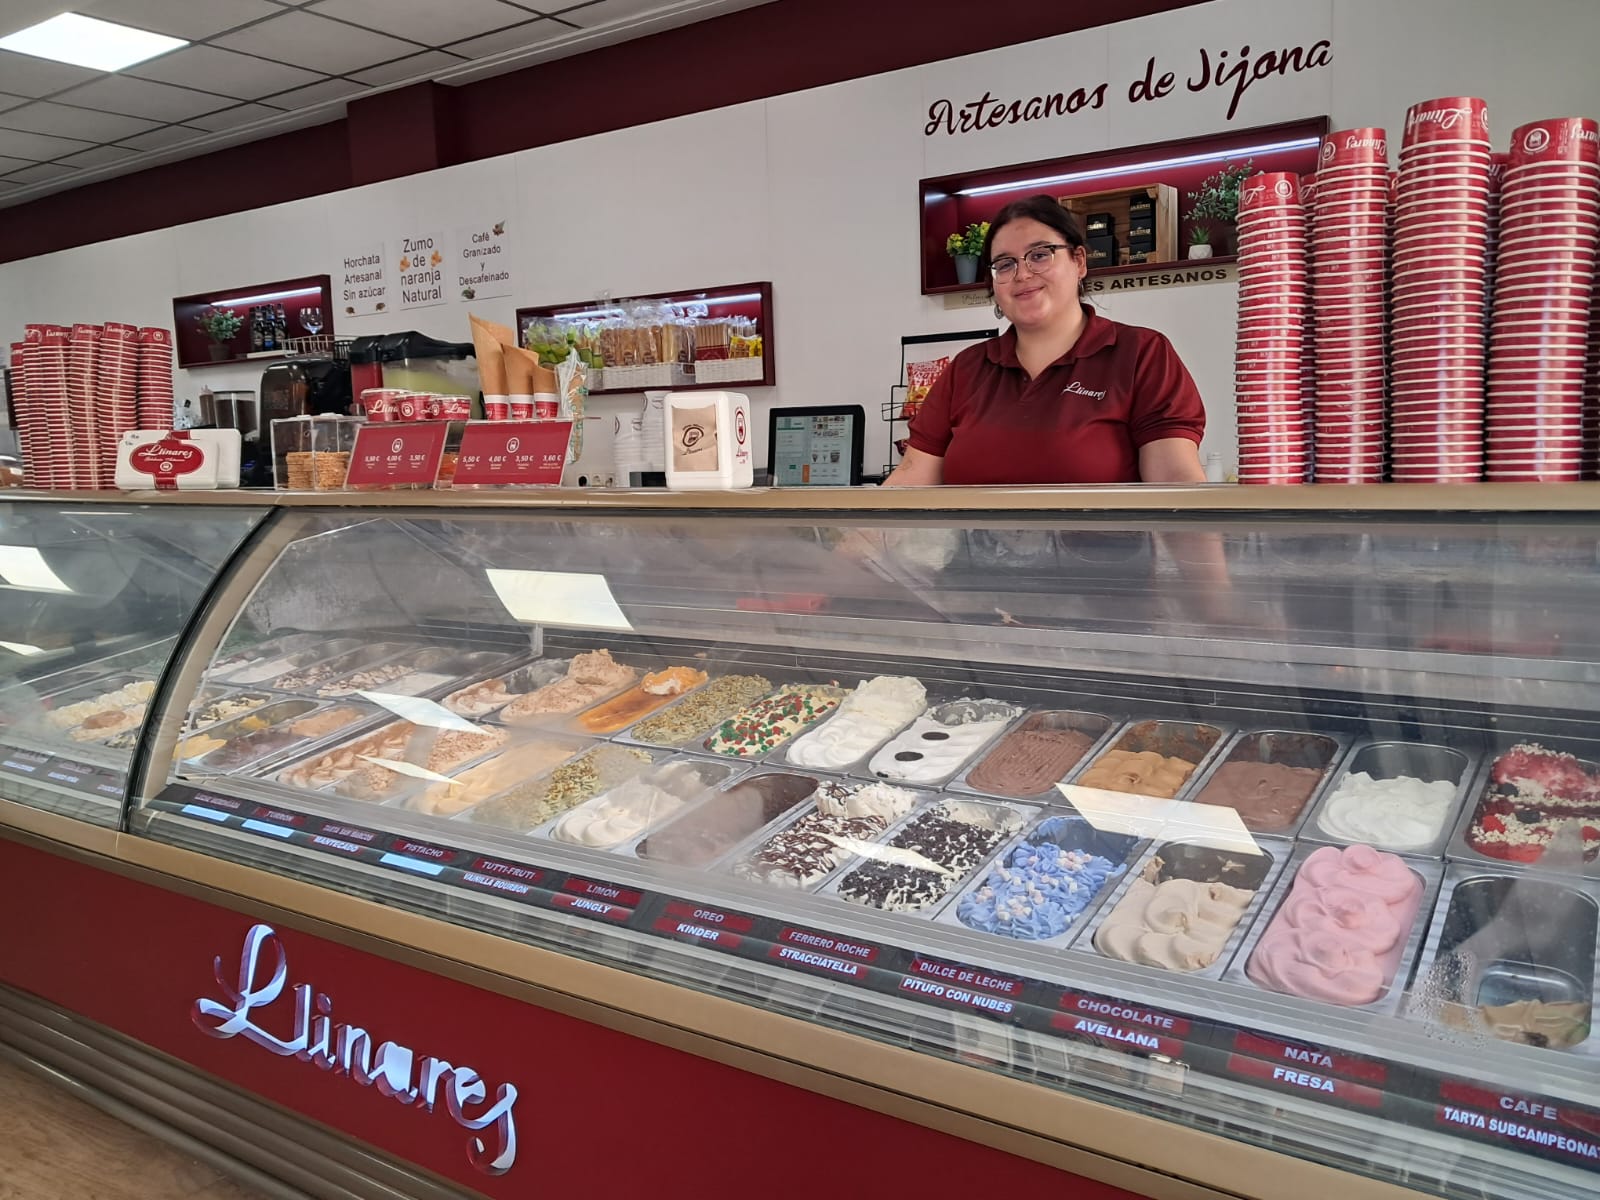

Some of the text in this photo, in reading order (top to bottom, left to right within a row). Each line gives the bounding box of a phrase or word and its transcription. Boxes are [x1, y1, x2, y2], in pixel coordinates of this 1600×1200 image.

[924, 40, 1333, 136] Artesanos de Jijona
[403, 237, 433, 253] Zumo
[472, 233, 490, 244] Café
[343, 254, 380, 269] Horchata
[413, 254, 426, 268] de
[463, 246, 501, 259] Granizado
[480, 262, 485, 271] y
[344, 269, 382, 285] Artesanal
[400, 268, 441, 286] naranja
[459, 271, 509, 286] Descafeinado
[1084, 268, 1227, 292] ES ARTESANOS
[343, 286, 386, 301] Sin azúcar
[402, 286, 442, 304] Natural
[138, 444, 193, 459] Llinares
[402, 843, 443, 858] PISTACHO
[482, 861, 536, 880] TUTTI-FRUTI
[493, 880, 529, 895] BOURBON
[586, 884, 619, 898] LIMON
[570, 898, 612, 914] JUNGLY
[693, 909, 724, 923] OREO
[676, 923, 719, 941] KINDER
[789, 931, 871, 958] FERRERO ROCHE
[779, 948, 858, 976] STRACCIATELLA
[919, 961, 1014, 993] DULCE DE LECHE
[903, 978, 1013, 1014] PITUFO CON NUBES
[1077, 998, 1174, 1030] CHOCOLATE
[1074, 1020, 1160, 1049] AVELLANA
[191, 924, 518, 1176] Llinares
[1284, 1046, 1333, 1069] NATA
[1272, 1067, 1335, 1093] FRESA
[1500, 1096, 1558, 1120] CAFE
[1443, 1107, 1486, 1129] TARTA
